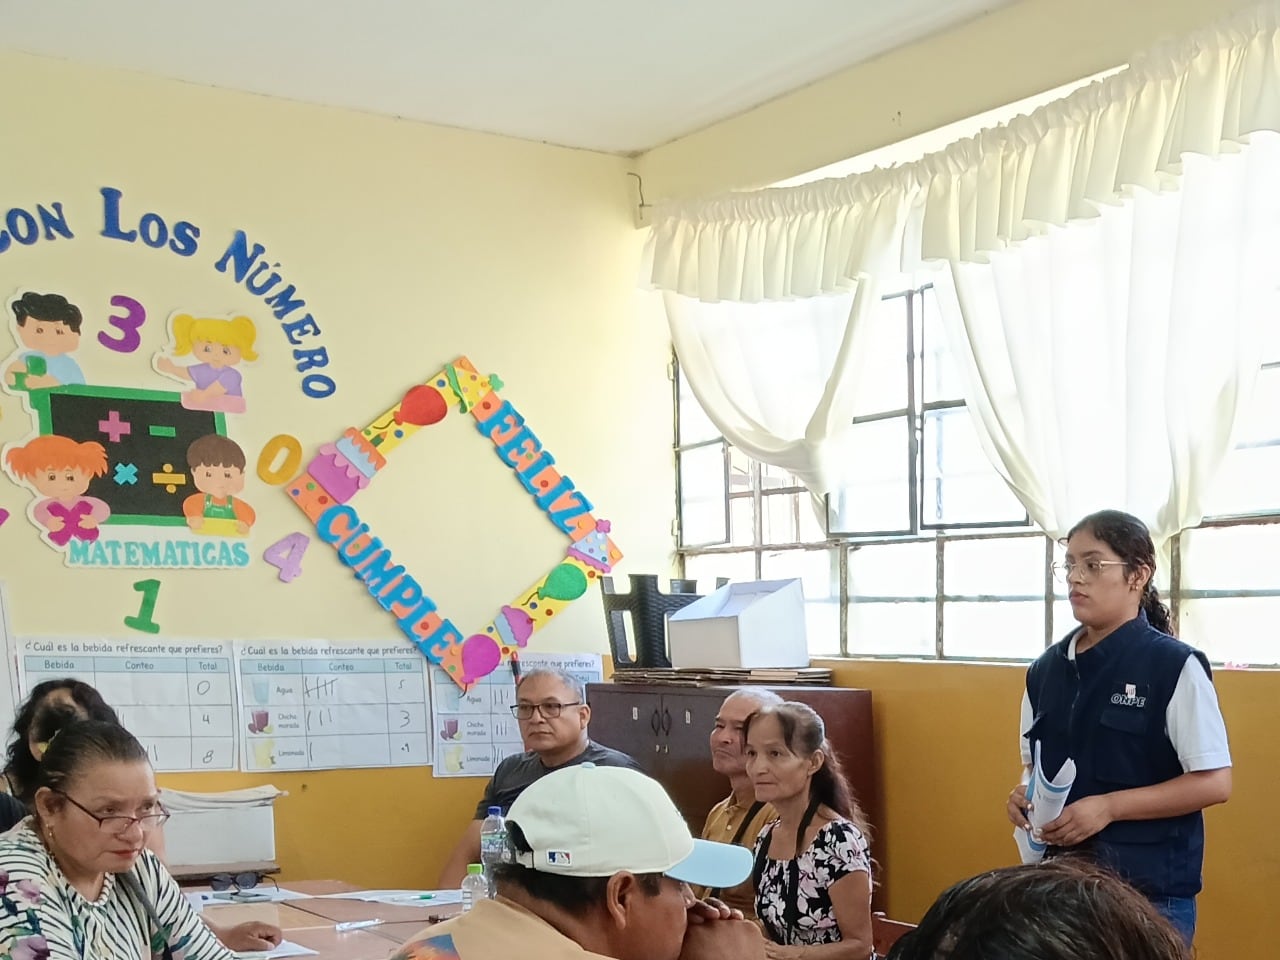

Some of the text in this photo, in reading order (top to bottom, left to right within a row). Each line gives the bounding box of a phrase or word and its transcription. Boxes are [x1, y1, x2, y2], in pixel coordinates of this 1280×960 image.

[97, 295, 146, 353] 3
[476, 400, 594, 535] FELIZ
[69, 540, 250, 567] MATEMATICAS
[263, 532, 310, 583] 4
[316, 505, 464, 665] CUMPLE
[124, 579, 161, 634] 1
[71, 643, 79, 652] la
[83, 643, 112, 652] bebida
[116, 643, 165, 654] refrescante
[168, 646, 183, 655] que
[185, 644, 223, 655] prefieres?
[292, 647, 318, 656] bebida
[321, 647, 365, 656] refrescante
[44, 661, 75, 670] Bebida
[125, 661, 154, 670] Conteo
[198, 662, 217, 671] Total
[257, 663, 285, 672] Bebida
[328, 663, 354, 671] Conteo
[394, 662, 412, 670] Total
[276, 686, 293, 695] Agua
[467, 695, 481, 703] Agua
[1111, 693, 1146, 707] ONPE
[203, 714, 210, 724] 4
[400, 710, 411, 728] 3
[203, 750, 214, 764] 8
